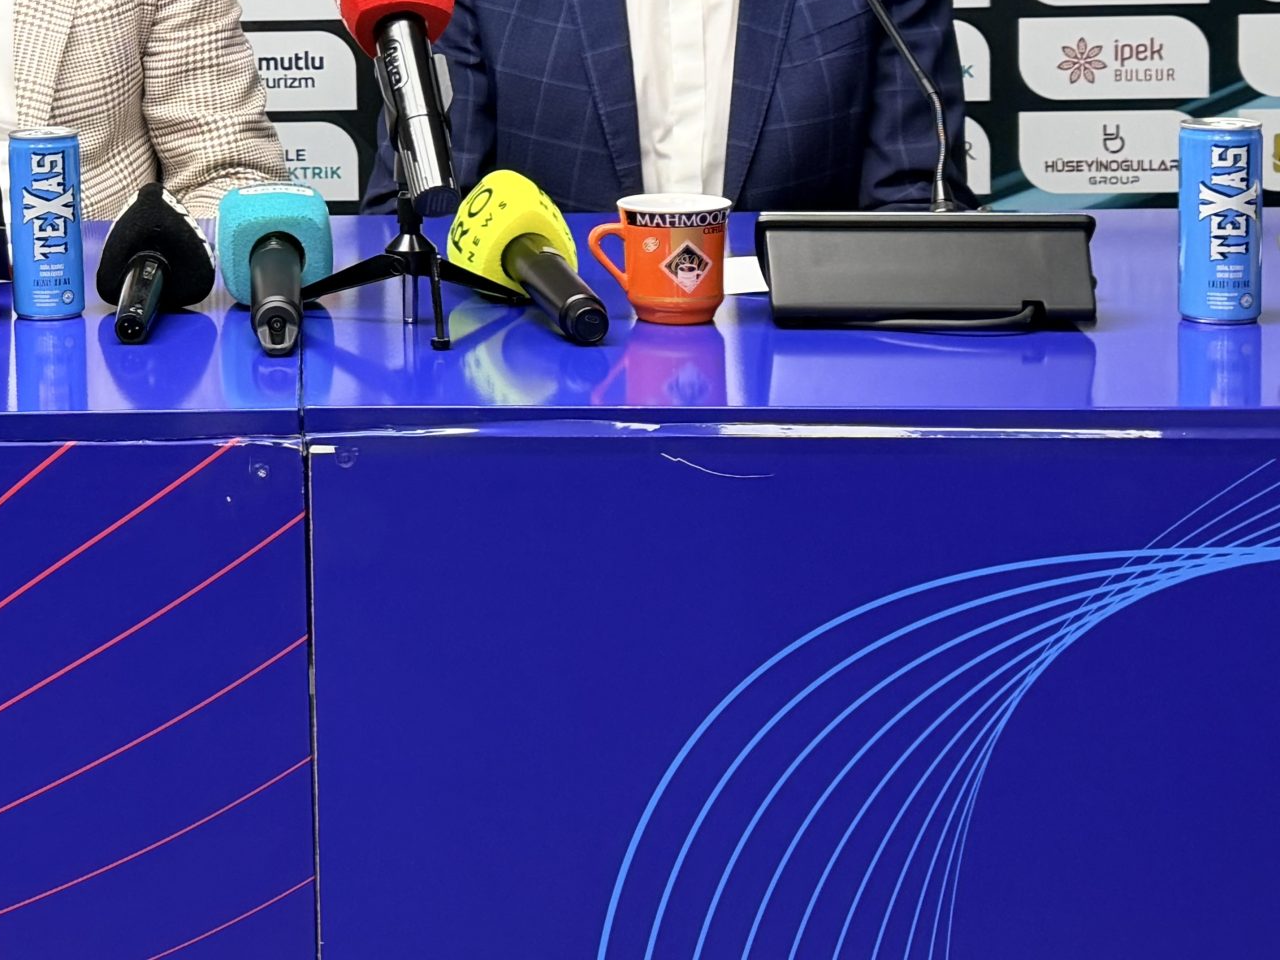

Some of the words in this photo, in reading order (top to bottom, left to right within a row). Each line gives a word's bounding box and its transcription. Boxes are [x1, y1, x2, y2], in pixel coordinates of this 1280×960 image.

[258, 50, 324, 71] mutlu
[1114, 37, 1165, 70] ipek
[1114, 68, 1176, 82] BULGUR
[1045, 157, 1179, 172] HÜSEYİNOĞULLAR
[1089, 175, 1140, 185] GROUP
[22, 150, 76, 262] TEXAS
[1198, 143, 1258, 262] TEXAS
